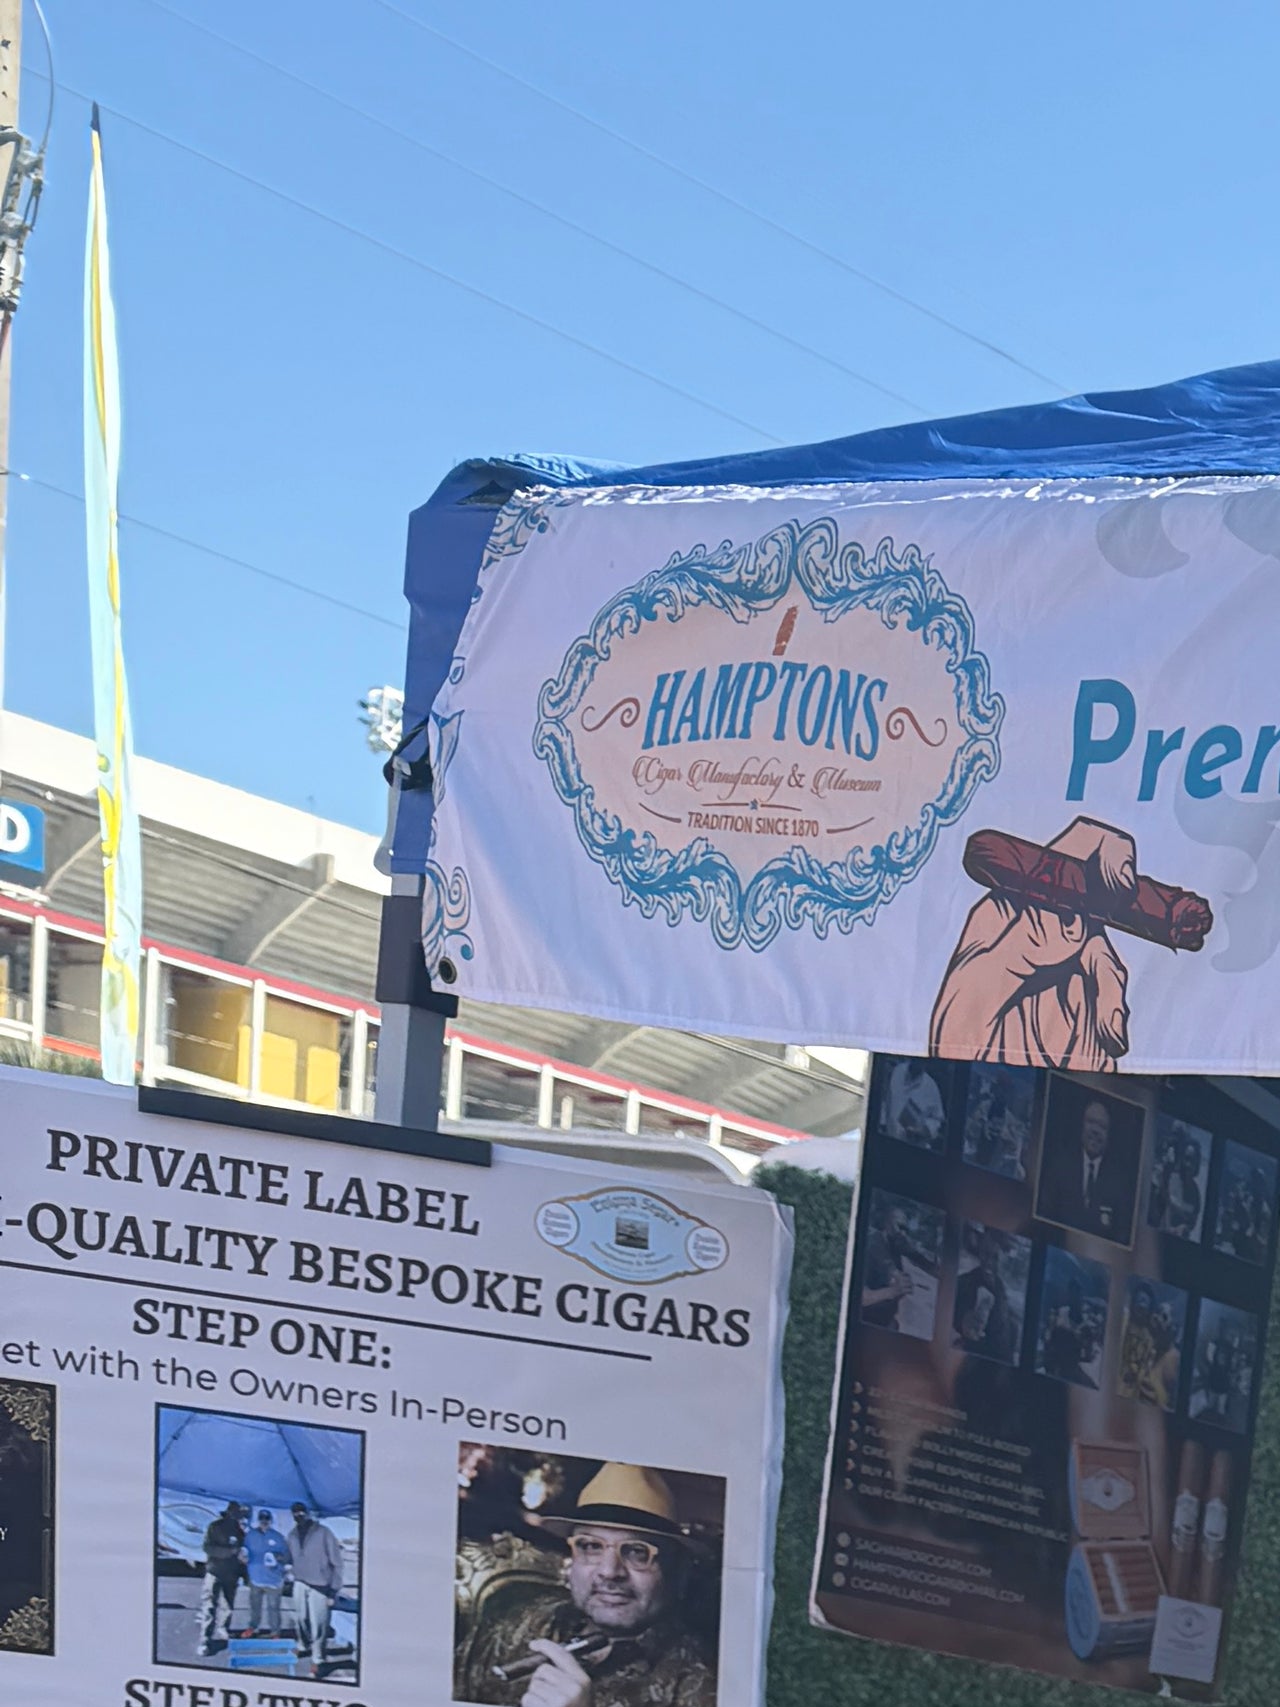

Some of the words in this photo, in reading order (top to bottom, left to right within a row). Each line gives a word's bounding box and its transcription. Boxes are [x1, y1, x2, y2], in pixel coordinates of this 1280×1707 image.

[642, 661, 888, 762] HAMPTONS
[632, 756, 683, 796] Cigar
[788, 764, 805, 788] &
[688, 811, 753, 834] TRADITION
[756, 817, 788, 836] SINCE
[791, 820, 819, 837] 1870
[46, 1129, 289, 1206] PRIVATE
[303, 1170, 481, 1236] LABEL
[0, 1196, 277, 1277] -QUALITY
[289, 1241, 541, 1317] BESPOKE
[555, 1283, 751, 1348] CIGARS
[132, 1298, 259, 1349] STEP
[270, 1319, 392, 1369] ONE:
[52, 1345, 139, 1381] with
[152, 1356, 218, 1392] the
[230, 1367, 378, 1414] Owners
[390, 1391, 567, 1441] In-Person
